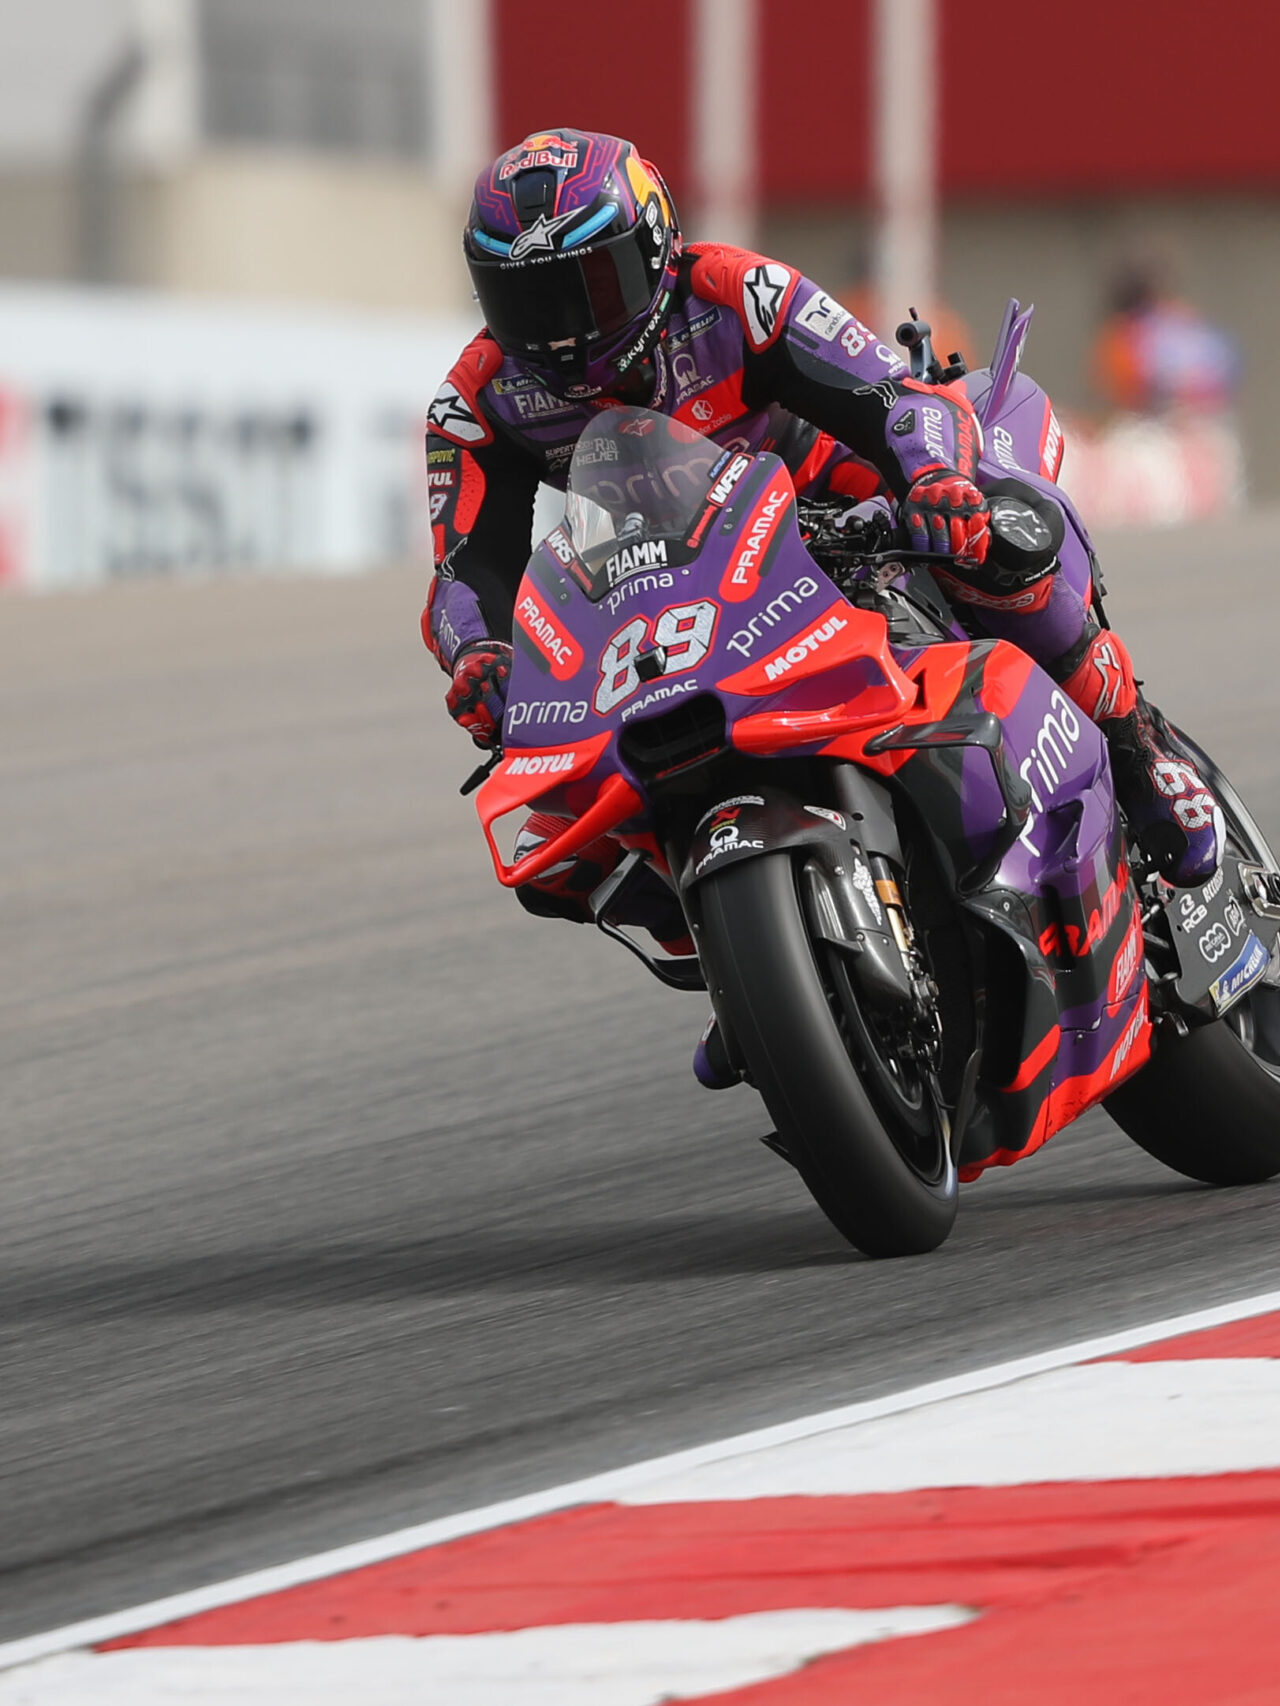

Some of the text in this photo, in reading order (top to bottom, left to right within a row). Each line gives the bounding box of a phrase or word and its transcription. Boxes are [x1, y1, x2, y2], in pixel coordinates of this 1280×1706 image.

[535, 151, 578, 168] Bull
[530, 256, 552, 265] YOU
[556, 246, 592, 260] WINGS
[514, 391, 570, 414] FIAM
[922, 407, 951, 462] prima
[576, 450, 618, 466] HELMET
[710, 456, 749, 503] WRS
[548, 531, 575, 564] WRS
[731, 490, 788, 584] PRAMAC
[606, 540, 668, 583] FIAMM
[607, 573, 673, 615] prima
[518, 596, 573, 665] PRAMAC
[726, 576, 819, 658] prima
[593, 599, 719, 716] 89
[764, 615, 848, 681] MOTUL
[507, 701, 588, 735] prima
[621, 679, 698, 722] PRAMAC
[505, 752, 576, 775] MOTUL
[1153, 761, 1216, 829] 89
[696, 840, 764, 875] PRAMAC
[1182, 904, 1208, 933] RCB
[1231, 944, 1263, 992] MICHELIN
